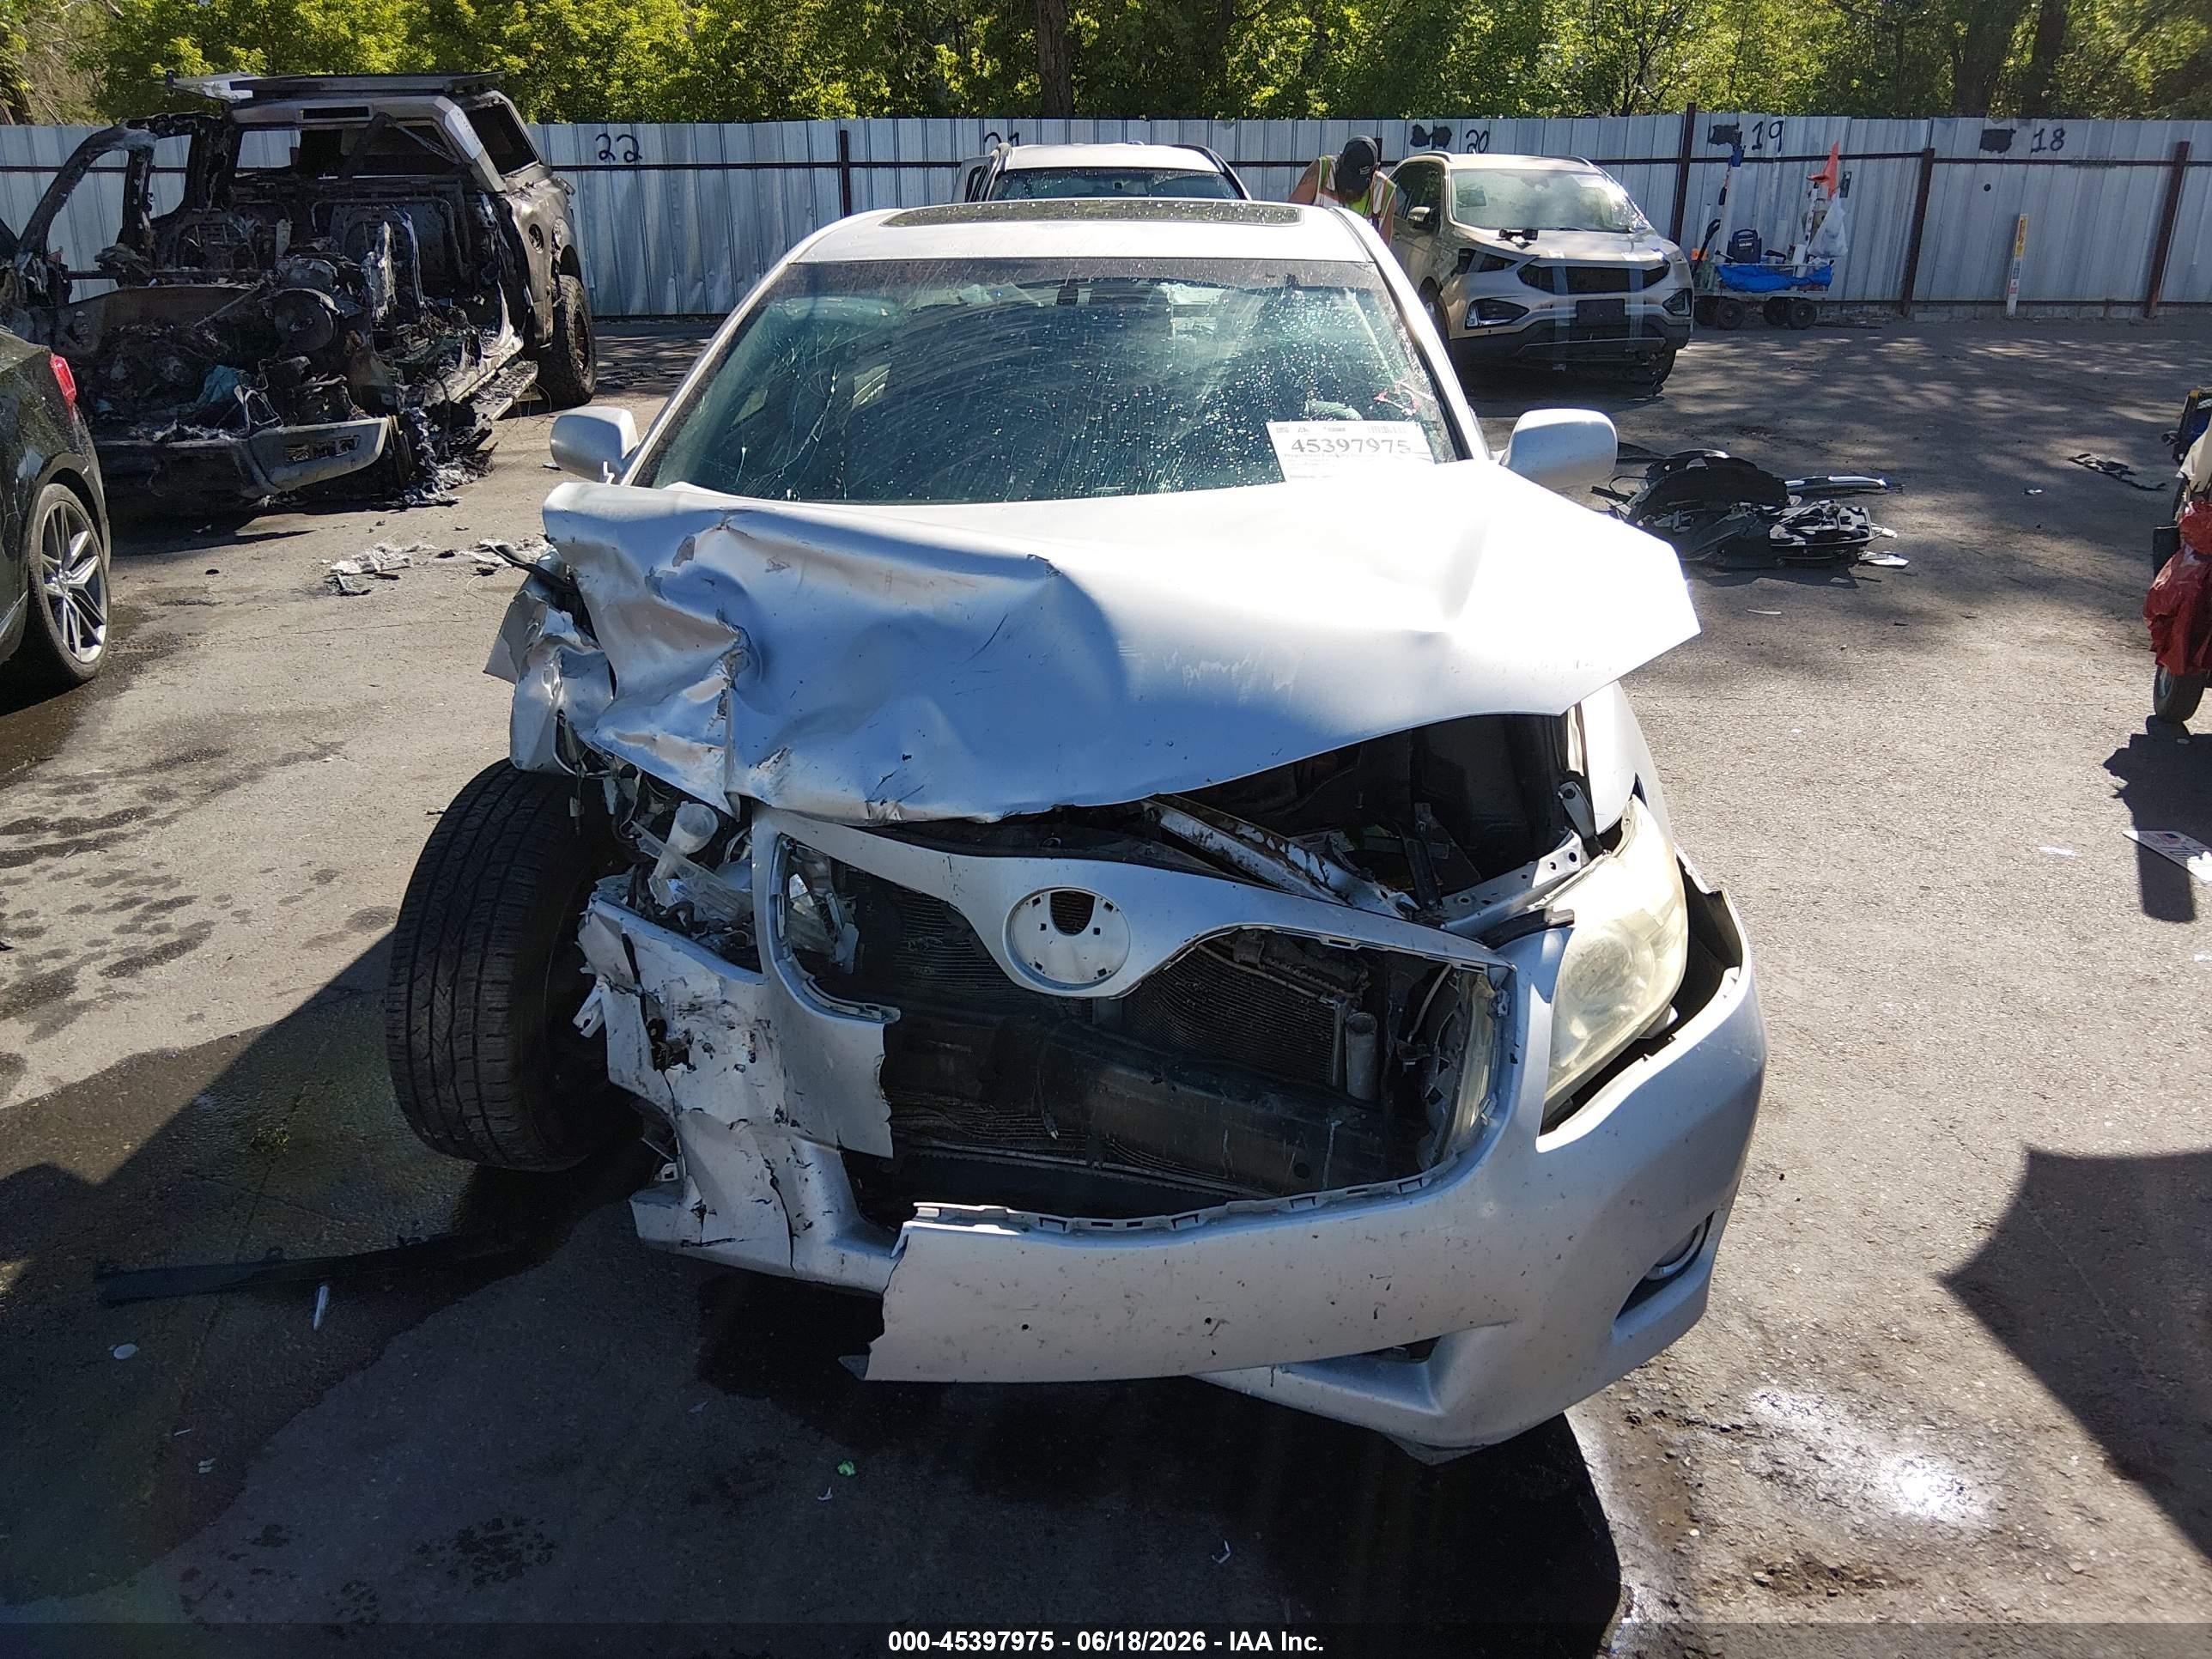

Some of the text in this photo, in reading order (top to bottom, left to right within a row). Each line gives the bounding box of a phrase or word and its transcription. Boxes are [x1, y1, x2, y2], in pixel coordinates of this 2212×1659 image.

[595, 132, 643, 163] 22
[1466, 130, 1490, 154] 20
[1752, 120, 1784, 153] 19
[2031, 127, 2066, 153] 18
[1291, 437, 1412, 454] 45397975
